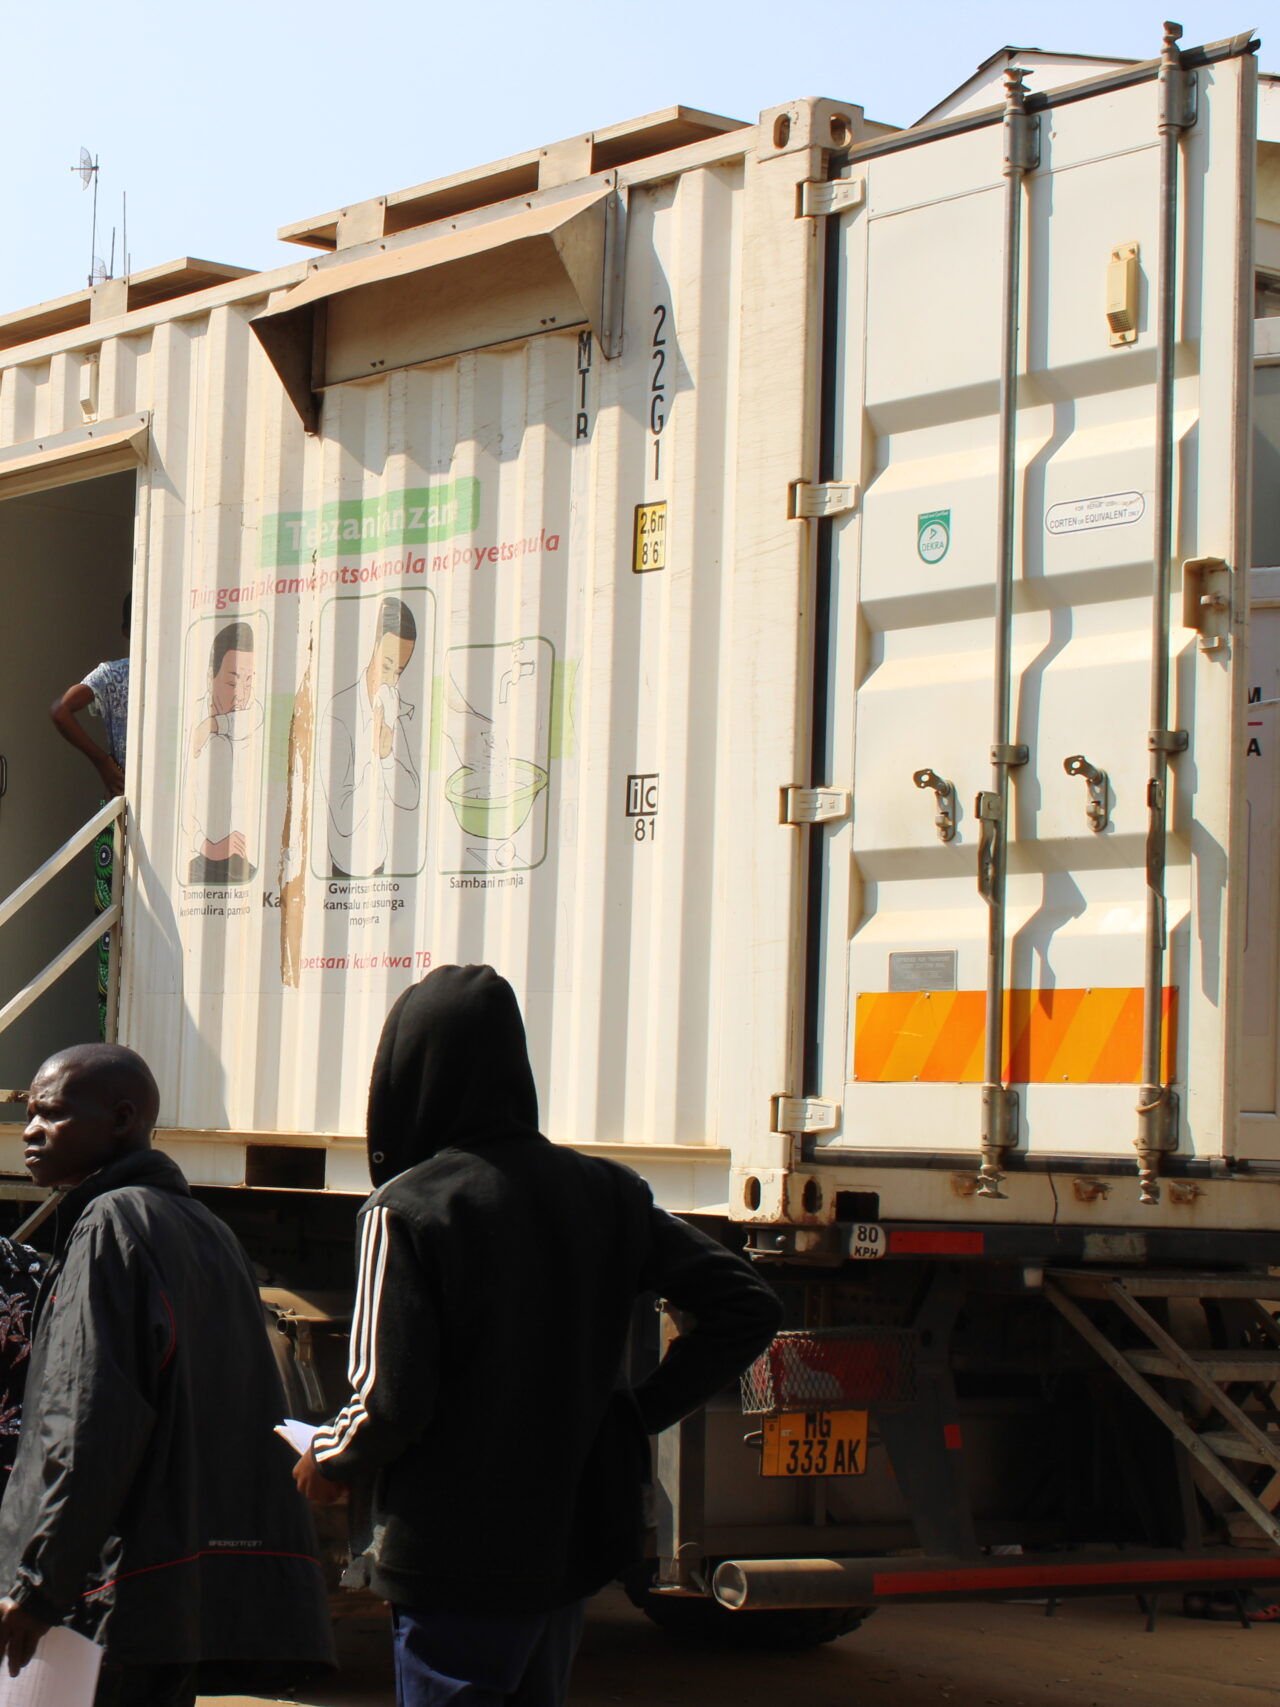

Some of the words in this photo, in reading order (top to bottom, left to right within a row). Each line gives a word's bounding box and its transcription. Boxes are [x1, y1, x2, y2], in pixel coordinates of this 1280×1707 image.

[650, 304, 667, 480] 22G1
[1050, 517, 1077, 529] CORTEN
[1085, 508, 1128, 524] EQUIVALENT
[922, 541, 944, 552] DEKRA
[634, 817, 655, 841] 81
[381, 951, 412, 969] kwa
[415, 952, 432, 969] TB
[857, 1225, 878, 1243] 80
[853, 1245, 878, 1258] KPH
[786, 1439, 828, 1474] 333
[833, 1439, 861, 1474] AK
